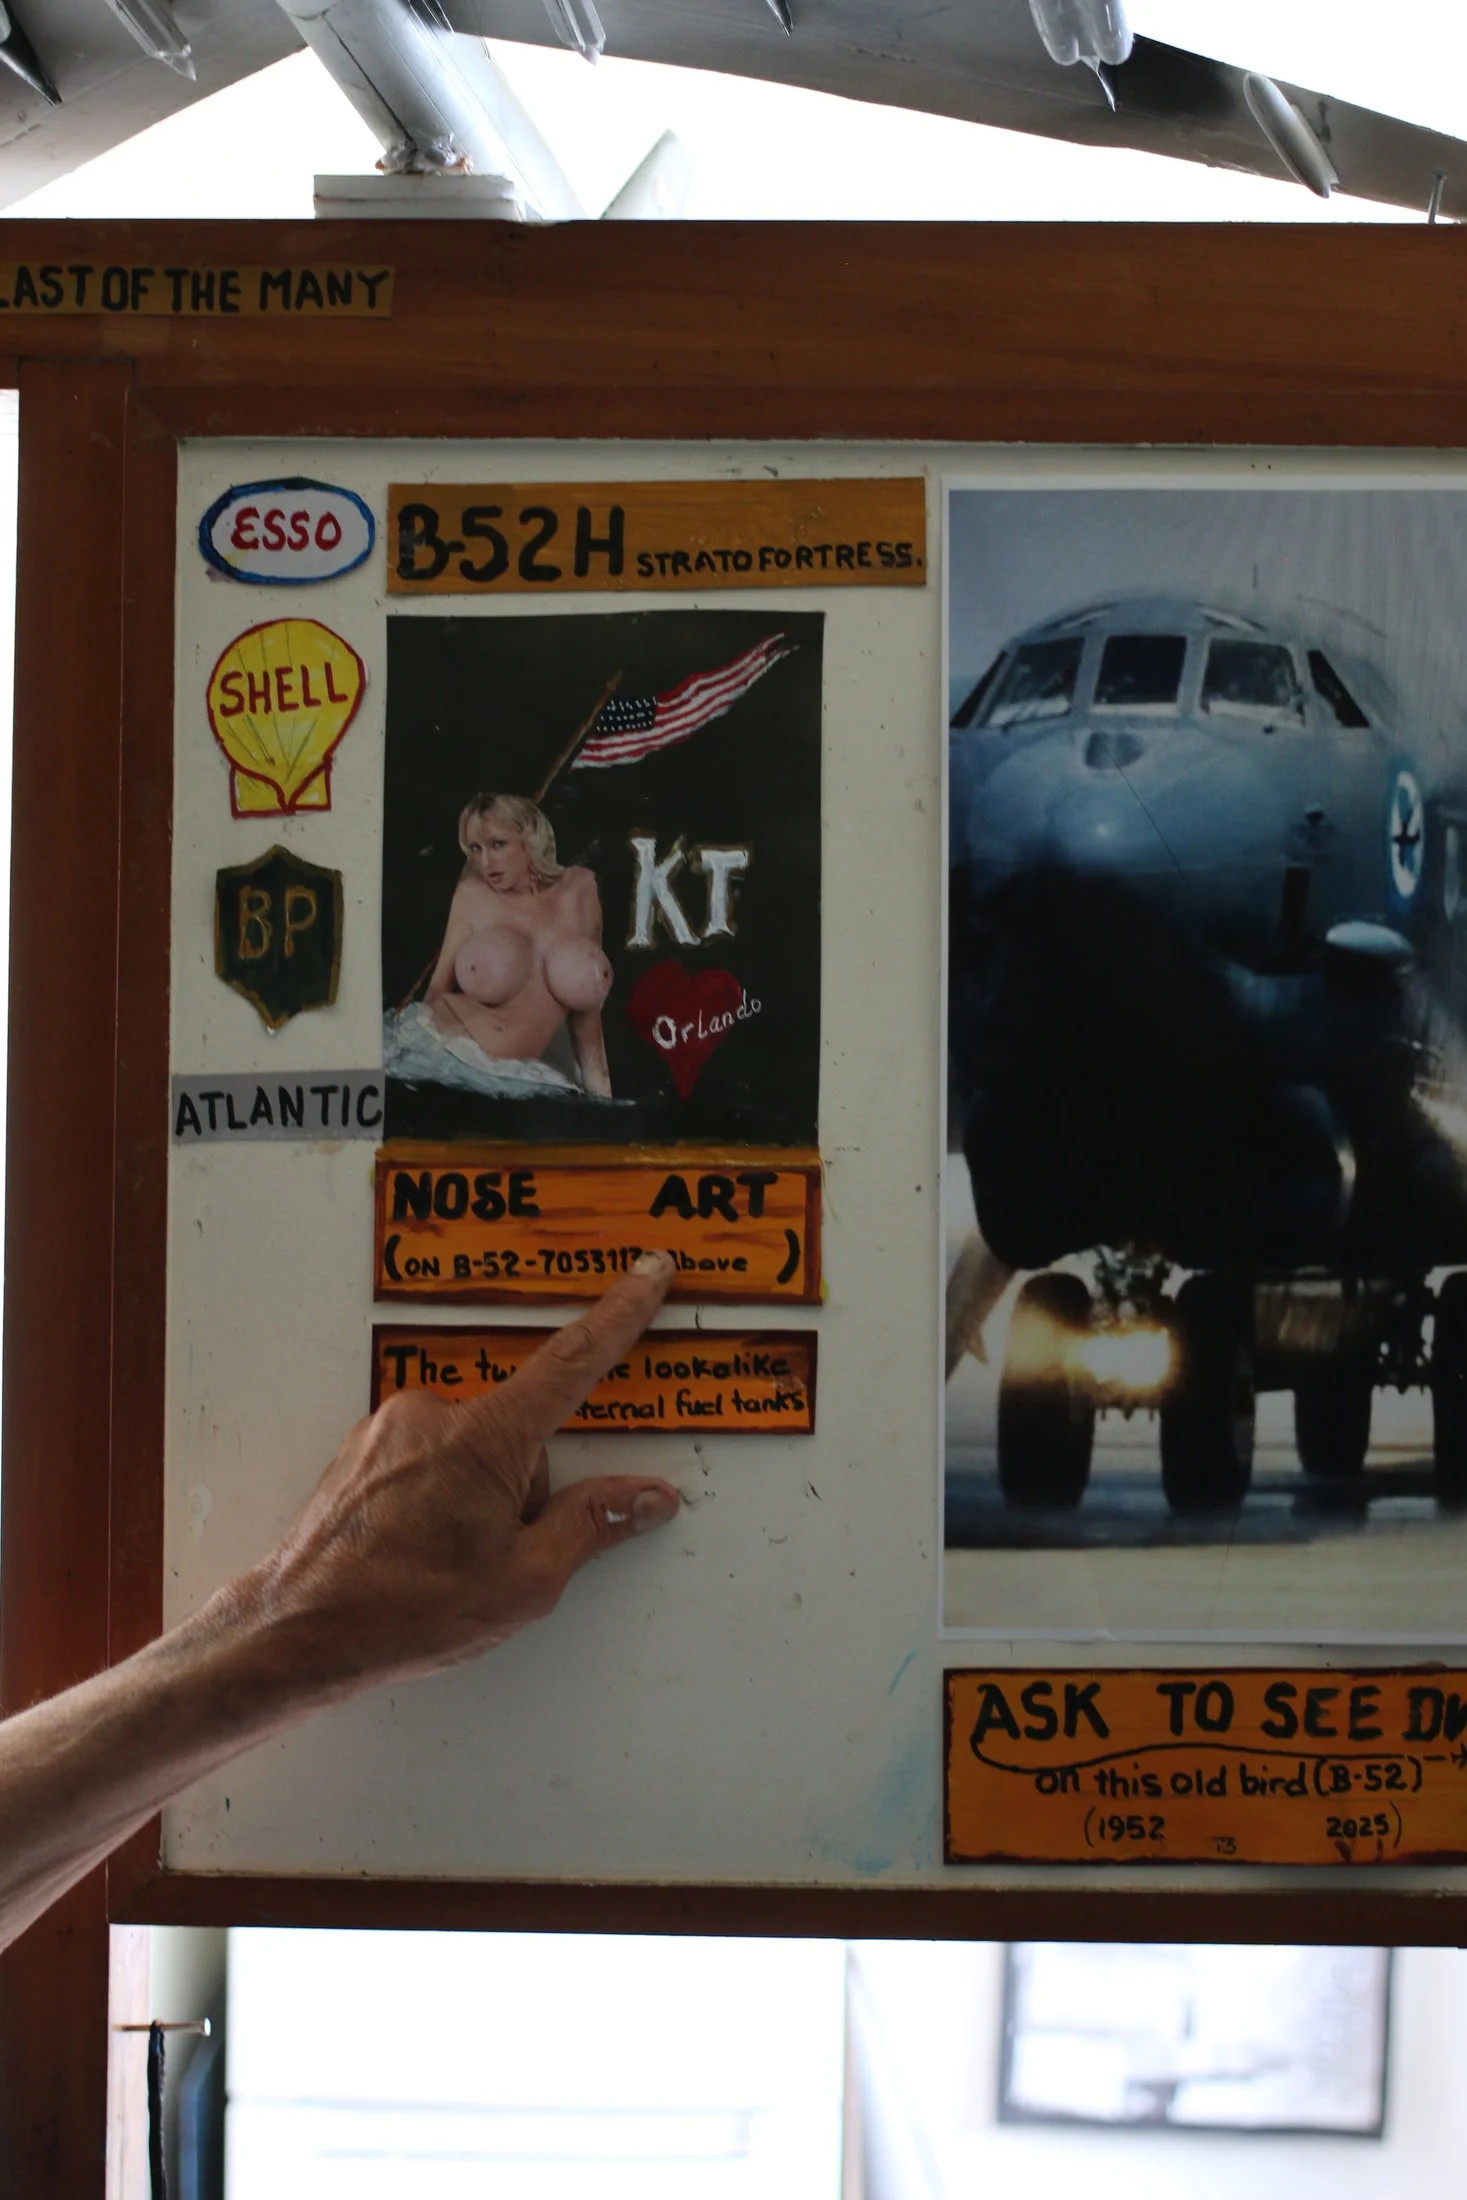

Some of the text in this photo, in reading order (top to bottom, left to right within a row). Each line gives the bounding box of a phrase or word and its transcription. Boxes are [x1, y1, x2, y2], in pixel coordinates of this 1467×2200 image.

[0, 266, 390, 313] AST OF THE MANY
[230, 507, 342, 551] ESSO
[396, 503, 625, 583] B-52H
[219, 661, 348, 717] SHELL
[627, 834, 751, 947] KT
[238, 885, 317, 960] BP
[175, 1085, 382, 1137] ATLANTIC
[393, 1172, 778, 1221] NOSE ART
[384, 1345, 463, 1389] The
[645, 1352, 790, 1380] lookalike
[676, 1388, 722, 1418] fuel
[731, 1389, 805, 1414] tanks
[971, 1681, 1110, 1742] ASK
[1156, 1681, 1234, 1737] TO
[1260, 1682, 1383, 1740] SEE
[1035, 1769, 1081, 1795] on
[1094, 1762, 1162, 1797] this
[1170, 1765, 1227, 1797] old
[1085, 1807, 1165, 1847] (1952
[1326, 1800, 1403, 1848] 2025)
